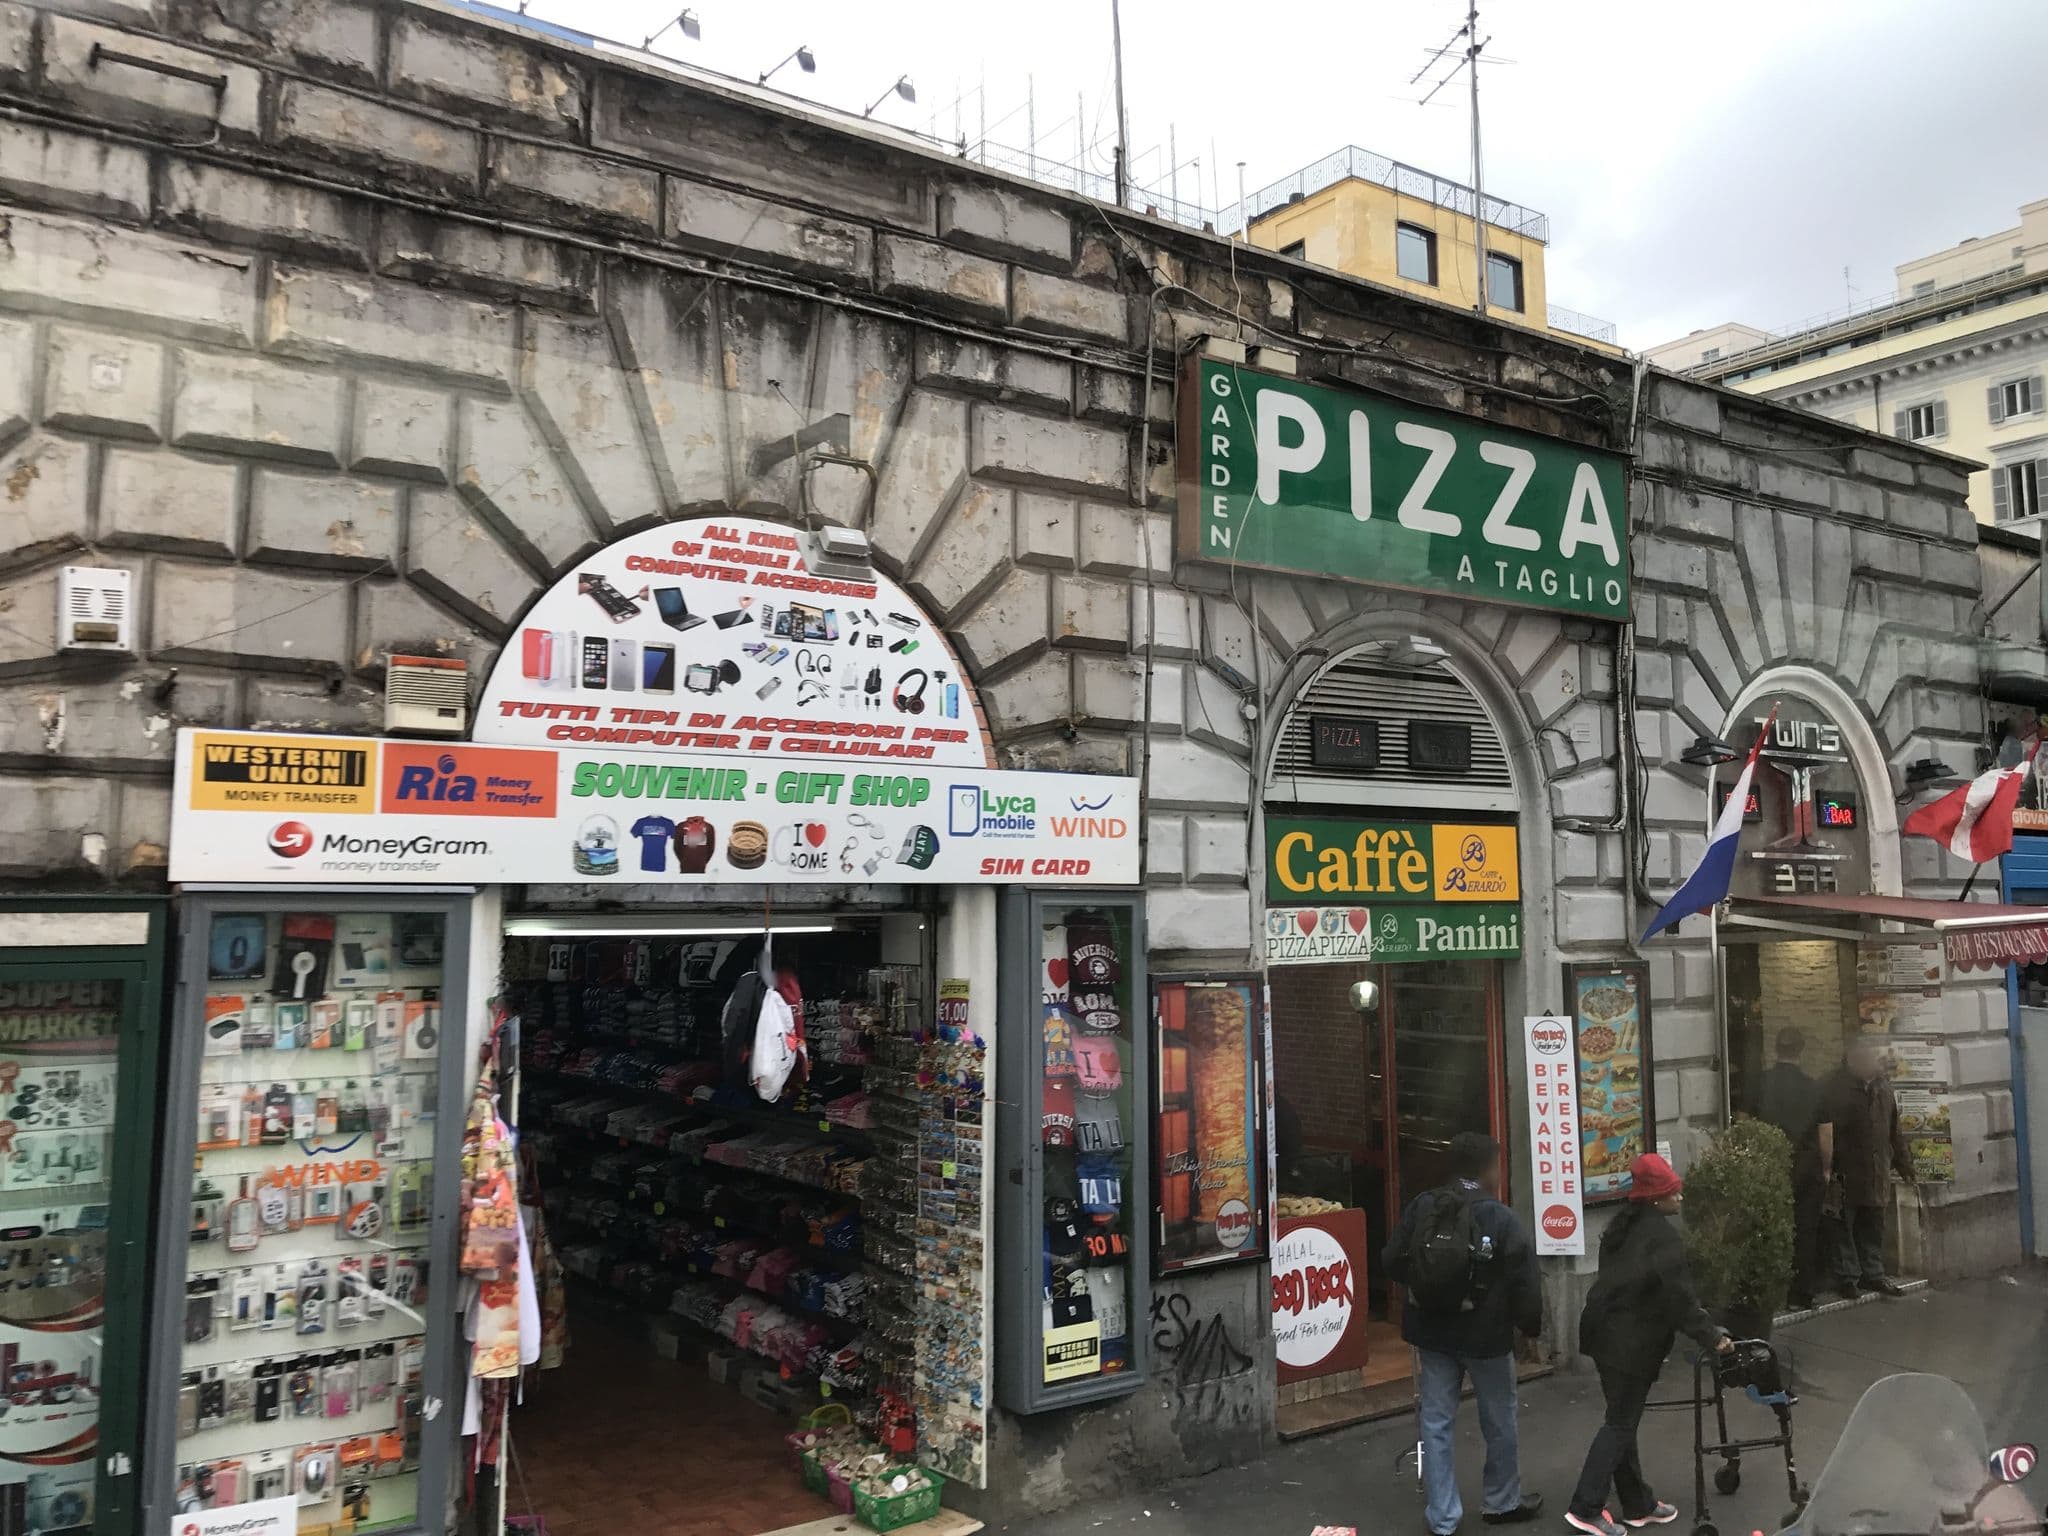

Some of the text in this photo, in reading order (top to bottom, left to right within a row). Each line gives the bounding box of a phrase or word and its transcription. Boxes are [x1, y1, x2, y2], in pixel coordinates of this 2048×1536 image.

[1209, 374, 1231, 549] GARDEN
[1256, 387, 1621, 567] PIZZA
[702, 523, 741, 543] ALL
[672, 541, 703, 557] OF
[709, 546, 790, 569] MOBILE
[625, 555, 878, 599] COMPUTER ACCESORIES
[1456, 554, 1622, 606] A TAGLIO
[500, 701, 969, 744] TUTTI TIPI DI ACCESSORI PER
[547, 724, 936, 759] COMPUTER E CELLULARI
[1321, 727, 1361, 747] PIZZA
[206, 746, 341, 768] WESTERN
[249, 765, 341, 785] UNION
[396, 754, 478, 802] Ria
[485, 776, 533, 790] Money
[571, 761, 930, 808] SOUVENIR GIFT SHOP
[225, 790, 358, 804] MONEY TRANSFER
[485, 791, 544, 806] Transfer
[982, 789, 1036, 817] Lyca
[982, 815, 1036, 830] mobile
[1049, 816, 1128, 839] WIND
[1831, 807, 1853, 825] BAR
[321, 833, 488, 859] MoneyGram
[793, 823, 803, 847] I
[321, 857, 441, 874] money transfer
[791, 852, 828, 869] ROME
[980, 858, 1091, 876] SIM CARD
[1274, 829, 1428, 894] Caffè
[1289, 915, 1297, 936] I
[1341, 914, 1348, 934] I
[1416, 913, 1520, 952] Panini
[1266, 937, 1320, 958] PIZZA
[1318, 935, 1370, 957] PIZZA
[1946, 935, 1972, 962] BAR
[1973, 928, 2044, 960] RESTAURANT
[1534, 1063, 1553, 1195] BEVANDE
[1556, 1063, 1576, 1194] FRESCHE
[272, 1159, 382, 1189] WIND
[1277, 1240, 1316, 1265] HALAL
[1271, 1259, 1354, 1317] OOD ROCK
[1300, 1322, 1318, 1338] For
[1321, 1315, 1344, 1334] Soul
[1048, 1340, 1089, 1355] WESTERN
[1060, 1349, 1089, 1360] UNION
[204, 1517, 278, 1535] MoneyGram
